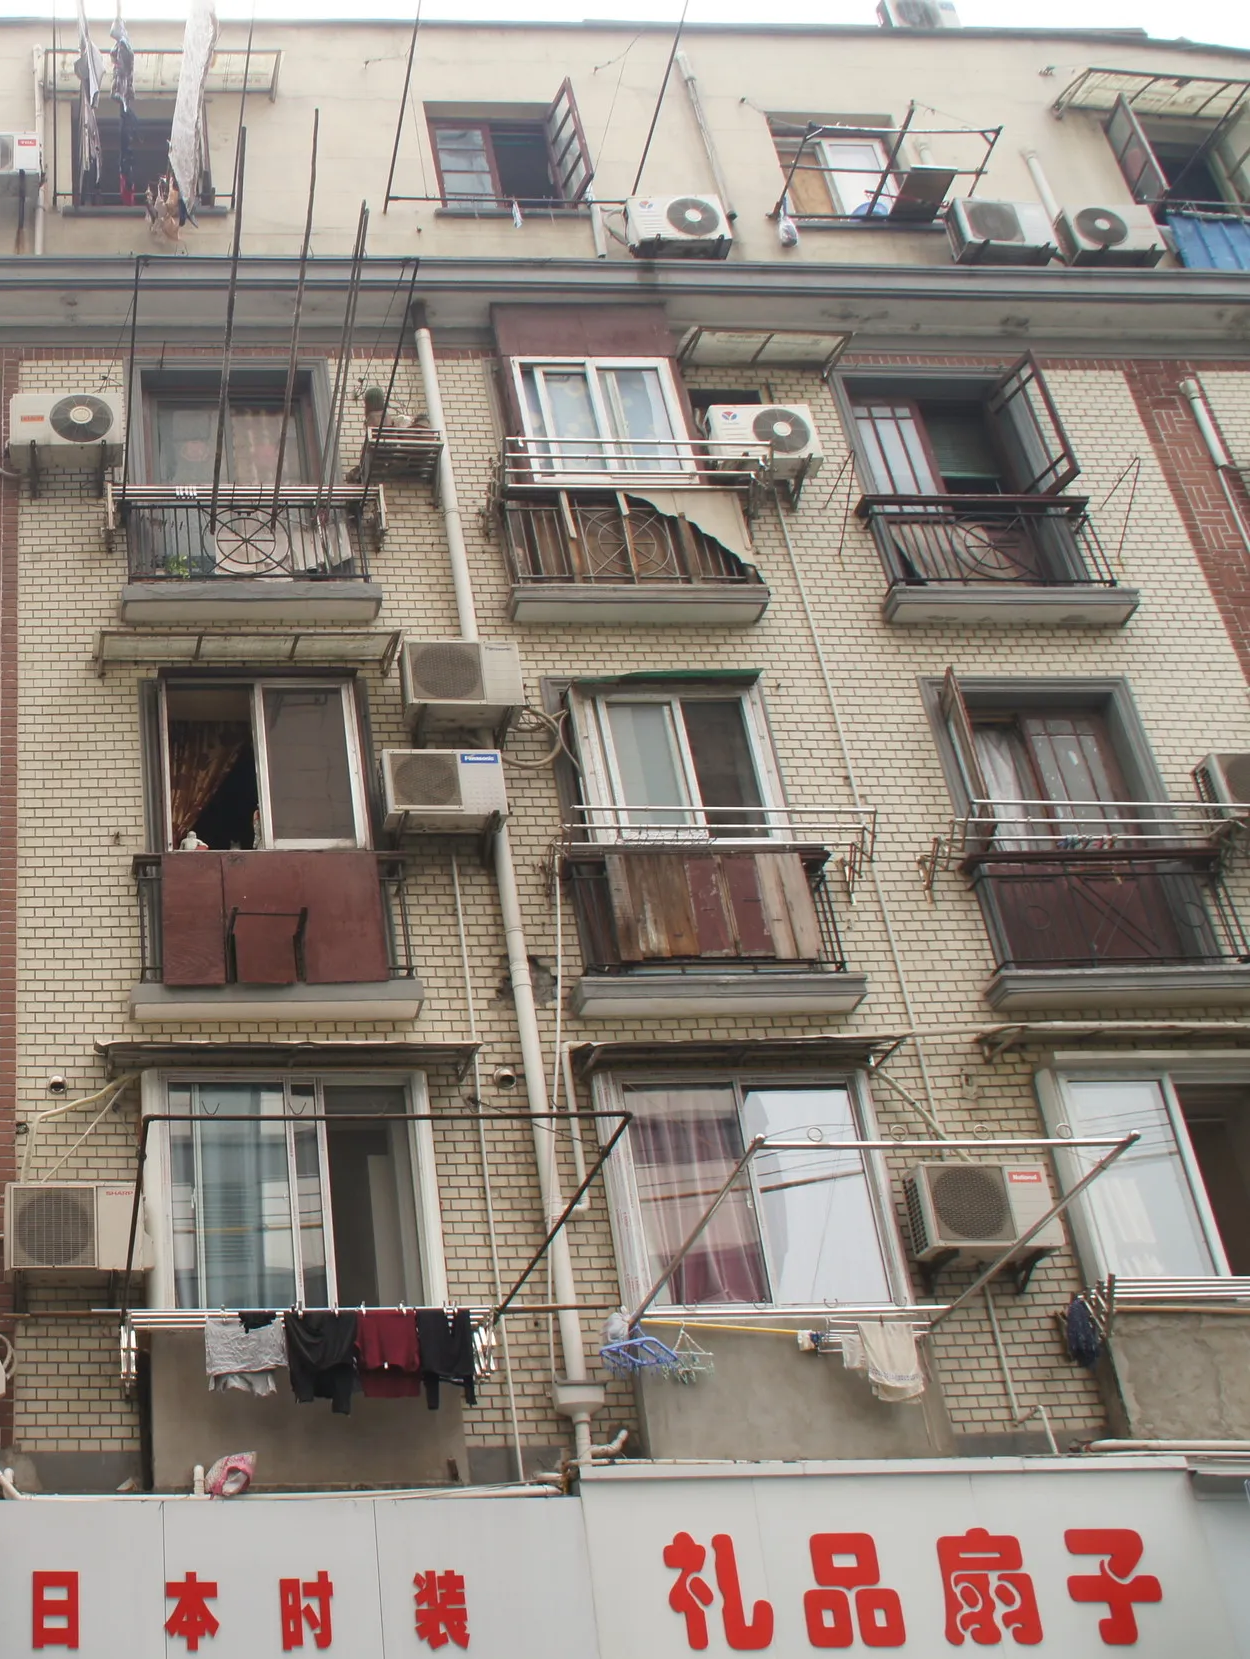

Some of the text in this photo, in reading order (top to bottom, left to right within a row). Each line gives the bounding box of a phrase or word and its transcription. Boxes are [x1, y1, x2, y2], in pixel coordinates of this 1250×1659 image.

[32, 1569, 470, 1652] 日本时装
[663, 1527, 1163, 1651] 礼品扇子
